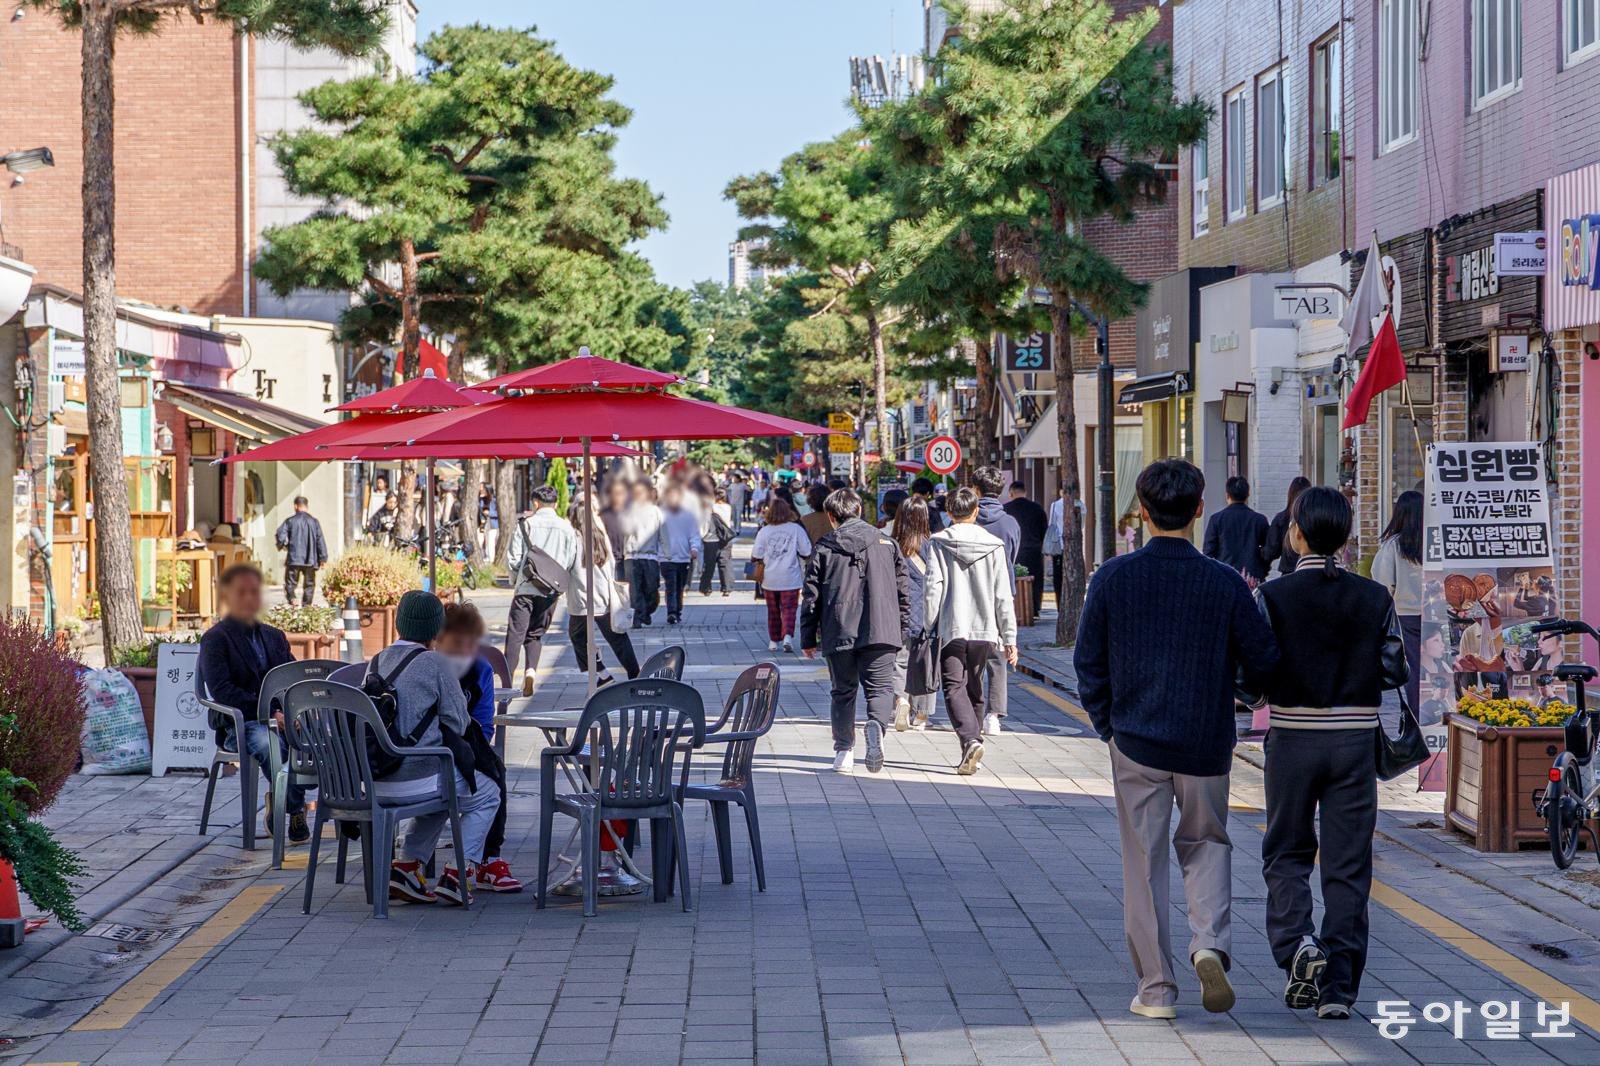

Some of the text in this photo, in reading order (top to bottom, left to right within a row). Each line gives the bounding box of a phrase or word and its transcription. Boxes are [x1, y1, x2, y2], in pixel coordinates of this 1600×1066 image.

[1562, 218, 1599, 286] Rolly
[1015, 348, 1043, 367] 25
[934, 447, 953, 463] 30
[1437, 449, 1540, 482] 십원빵
[1453, 505, 1532, 519] 피자/누텔라
[1445, 541, 1474, 556] 맛이
[1477, 541, 1547, 556] 다른겁니다
[172, 730, 206, 740] 홍콩와플
[173, 745, 204, 753] 커피&와인
